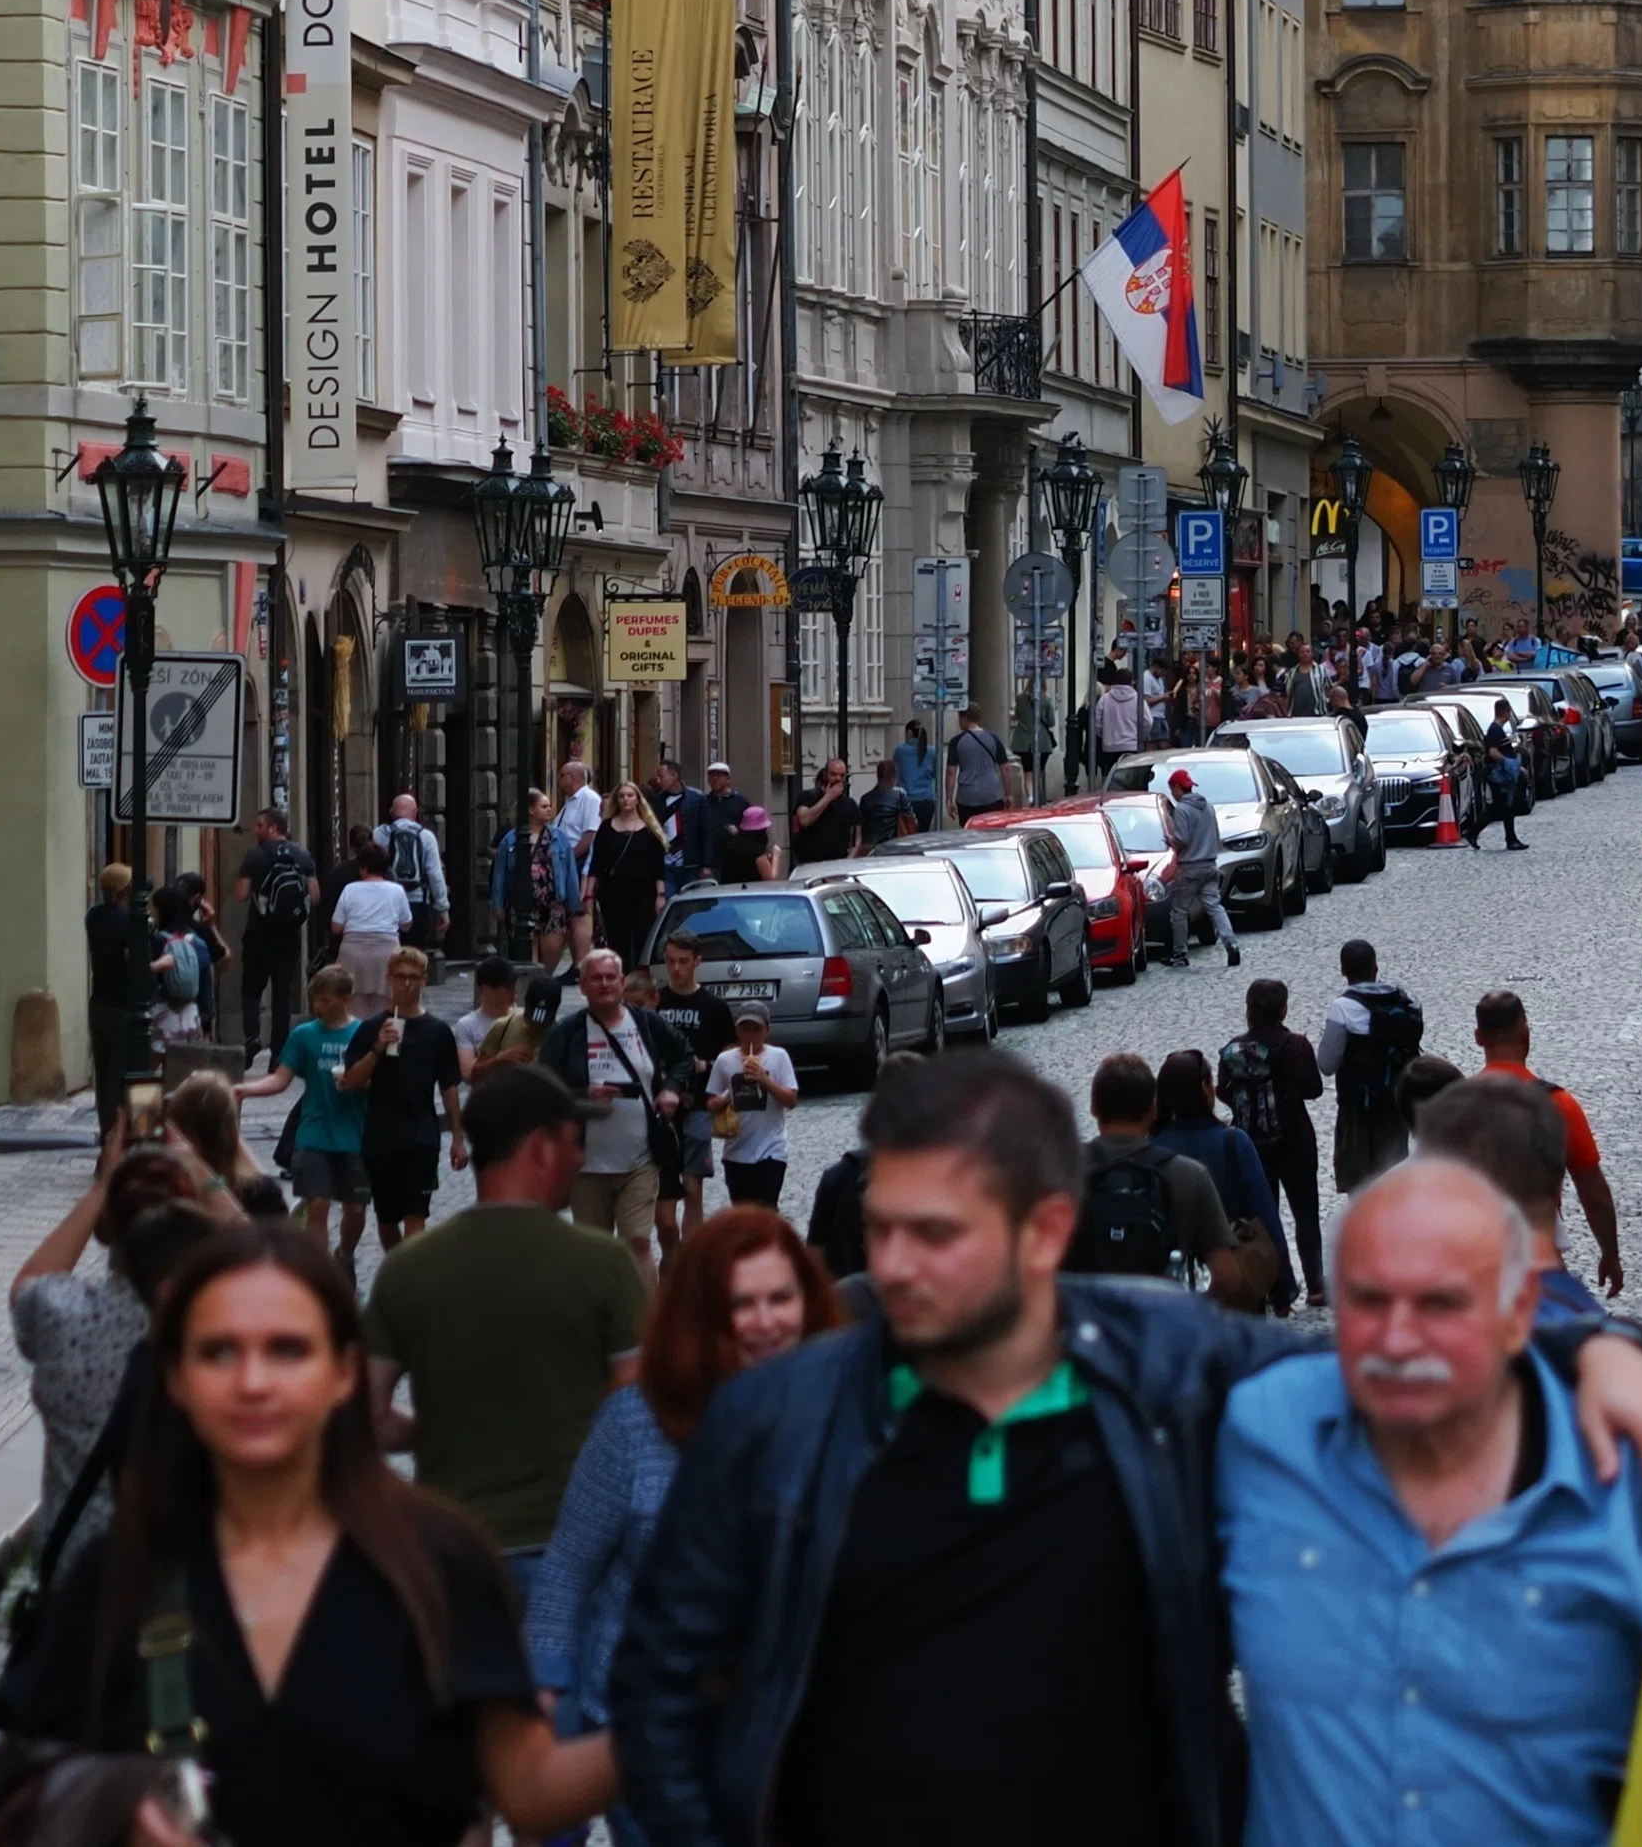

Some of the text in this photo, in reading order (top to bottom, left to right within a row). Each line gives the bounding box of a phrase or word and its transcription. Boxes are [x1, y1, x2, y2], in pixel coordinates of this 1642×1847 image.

[702, 93, 717, 140] ORLA
[631, 49, 655, 219] RESTAURACE
[304, 118, 341, 450] DESIGN HOTEL
[1428, 516, 1449, 544] P
[1188, 519, 1213, 555] P
[1182, 558, 1219, 567] RÉSERVÉ
[712, 570, 729, 593] PUB
[615, 615, 680, 626] PERFUMES
[627, 625, 668, 637] DUPES
[644, 639, 651, 649] &
[619, 650, 676, 662] ORIGINAL
[631, 662, 665, 674] GIFTS
[738, 983, 768, 996] 7392
